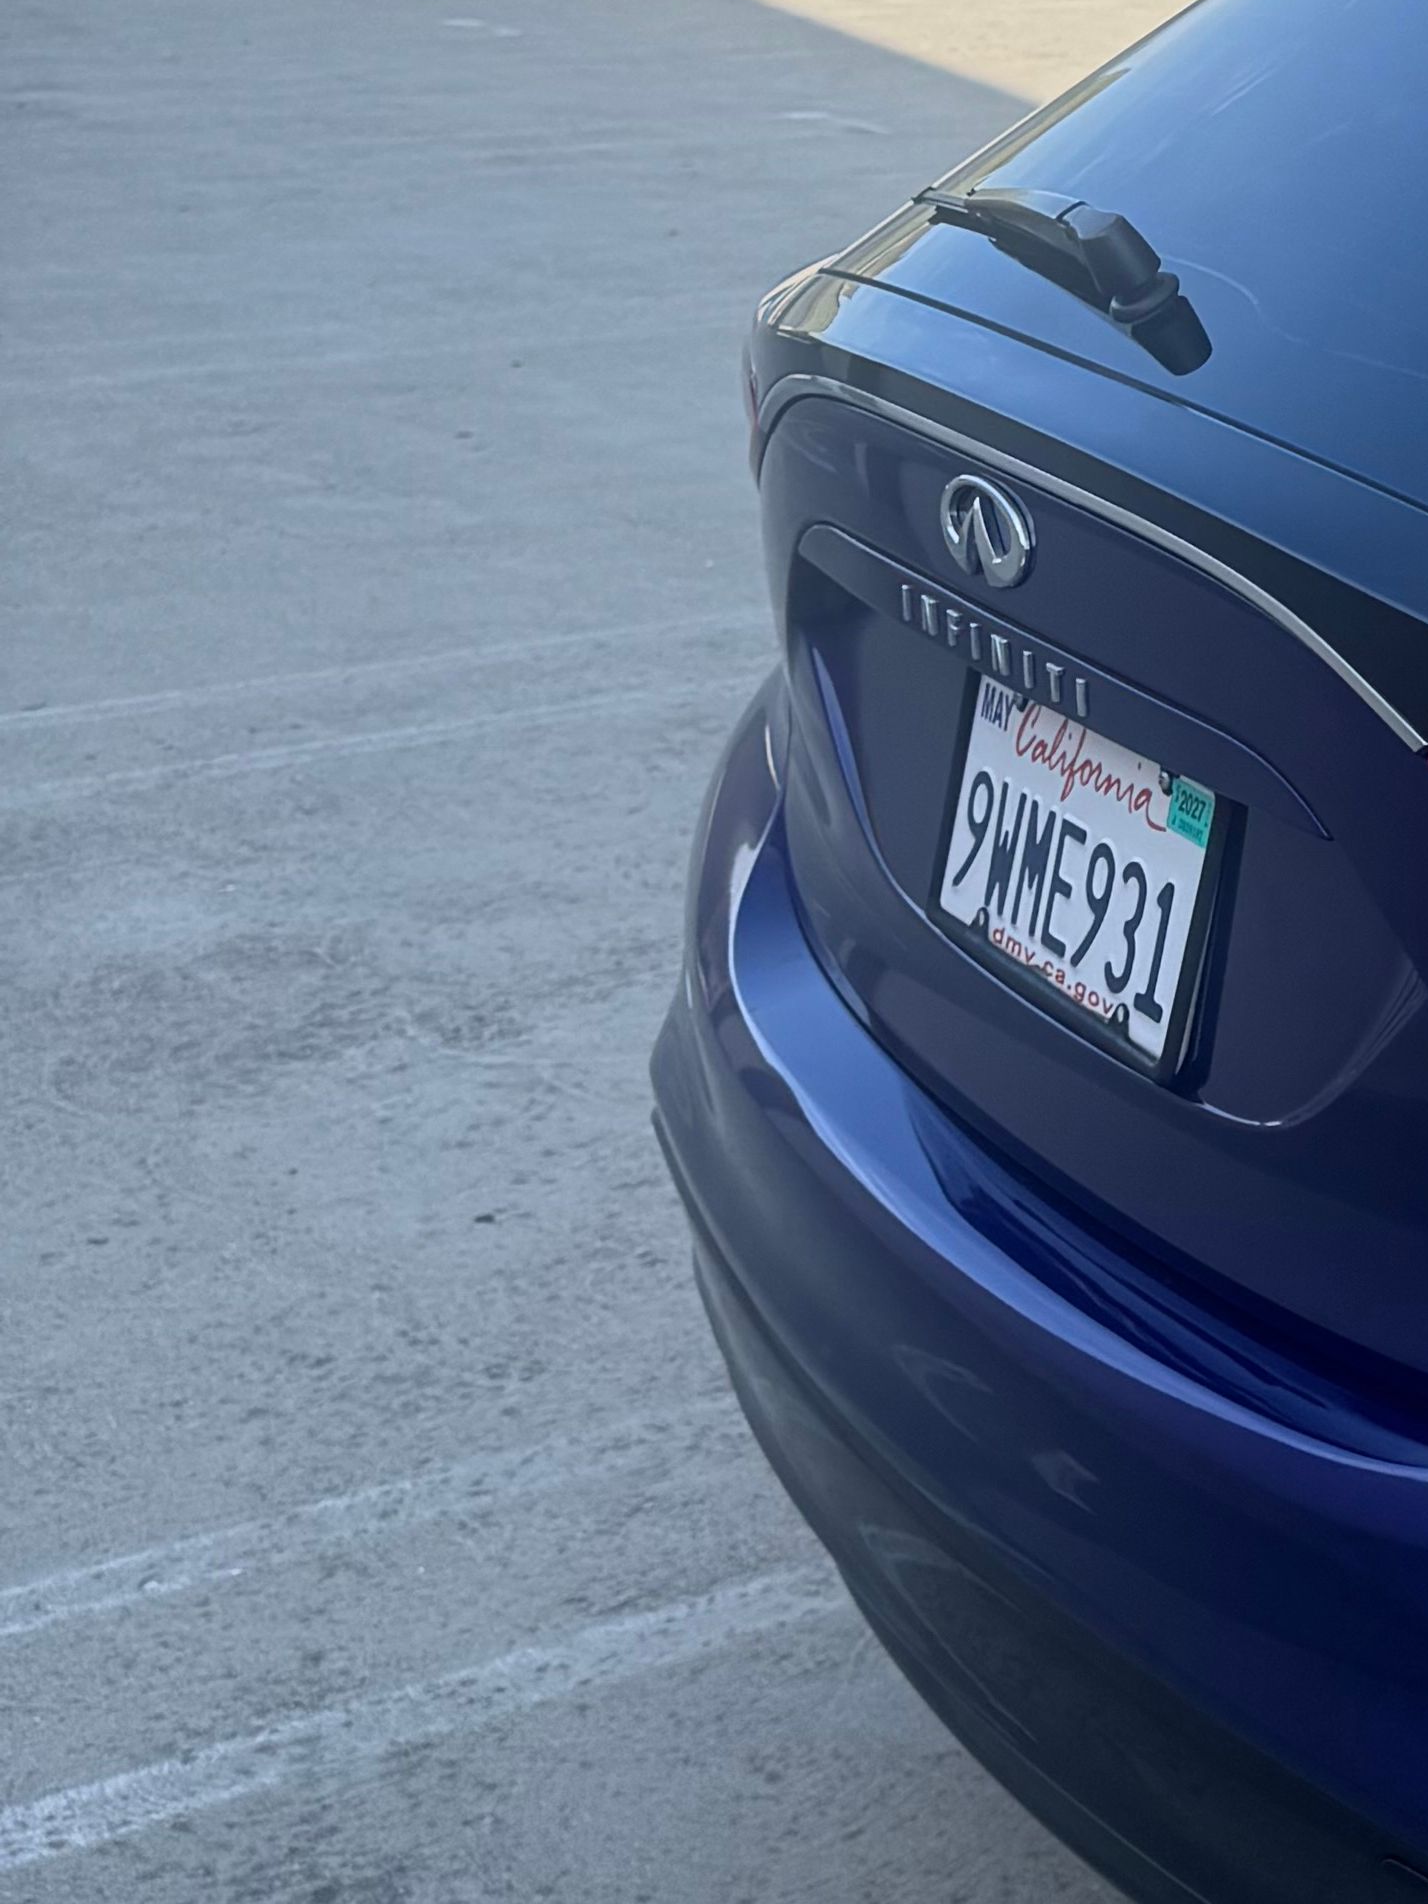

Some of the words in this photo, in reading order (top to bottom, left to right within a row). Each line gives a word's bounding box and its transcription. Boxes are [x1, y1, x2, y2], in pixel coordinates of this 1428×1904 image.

[901, 584, 1088, 718] INFINITI
[980, 682, 1015, 732] MAY
[1016, 702, 1167, 833] California
[1178, 790, 1207, 823] 2027
[952, 770, 1176, 1024] 9WME931
[992, 927, 1114, 1015] dmvca.gov
